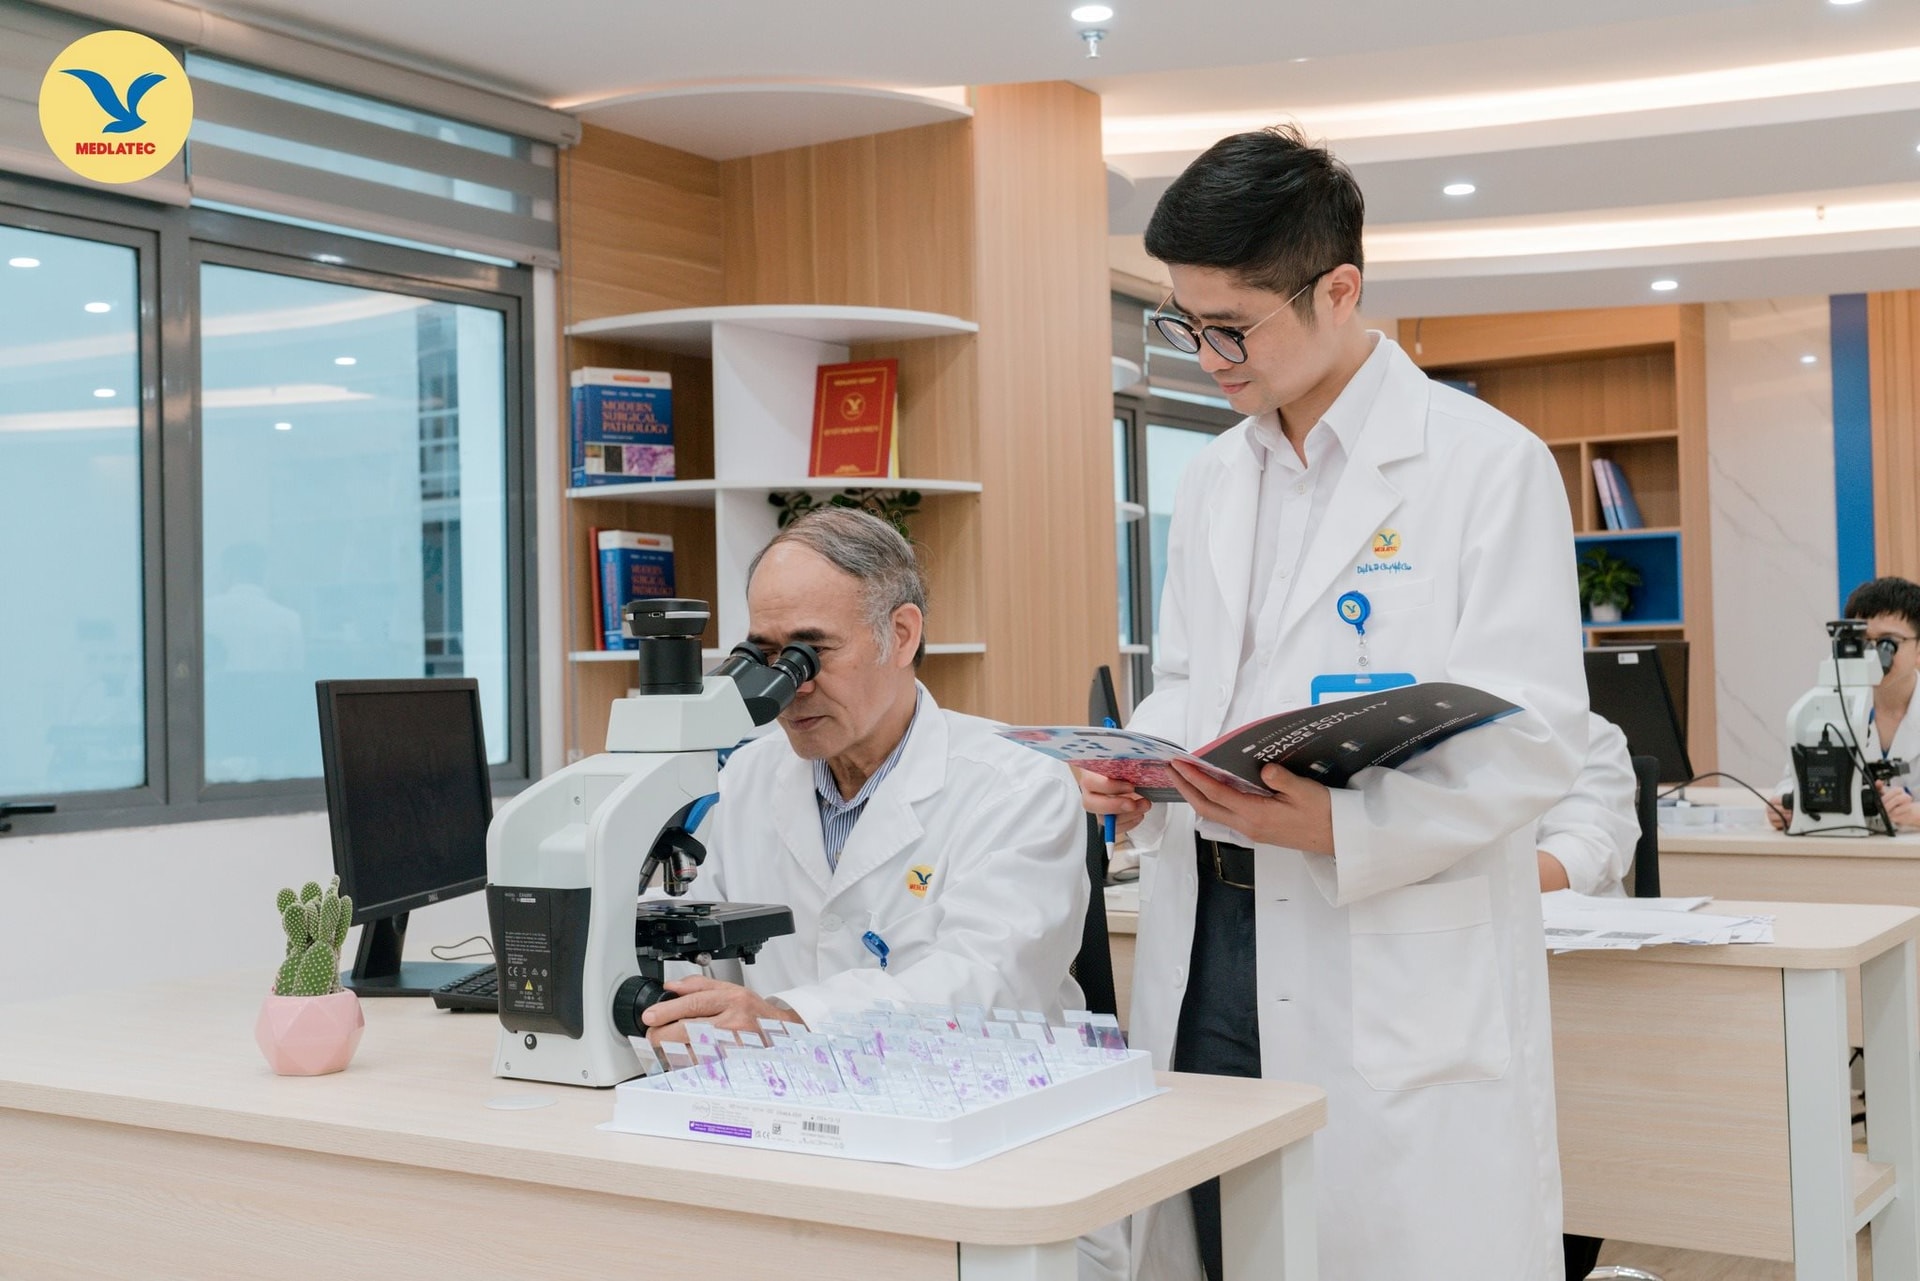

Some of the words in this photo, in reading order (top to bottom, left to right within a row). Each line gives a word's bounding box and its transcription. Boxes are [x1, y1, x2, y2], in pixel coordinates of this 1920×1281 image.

[602, 400, 652, 411] MODERN
[602, 411, 657, 422] SURGICAL
[602, 421, 669, 434] PATHOLOGY
[1253, 711, 1346, 760] 3DHISTECH
[1262, 731, 1315, 763] IMAGE
[1316, 700, 1388, 731] QUALITY
